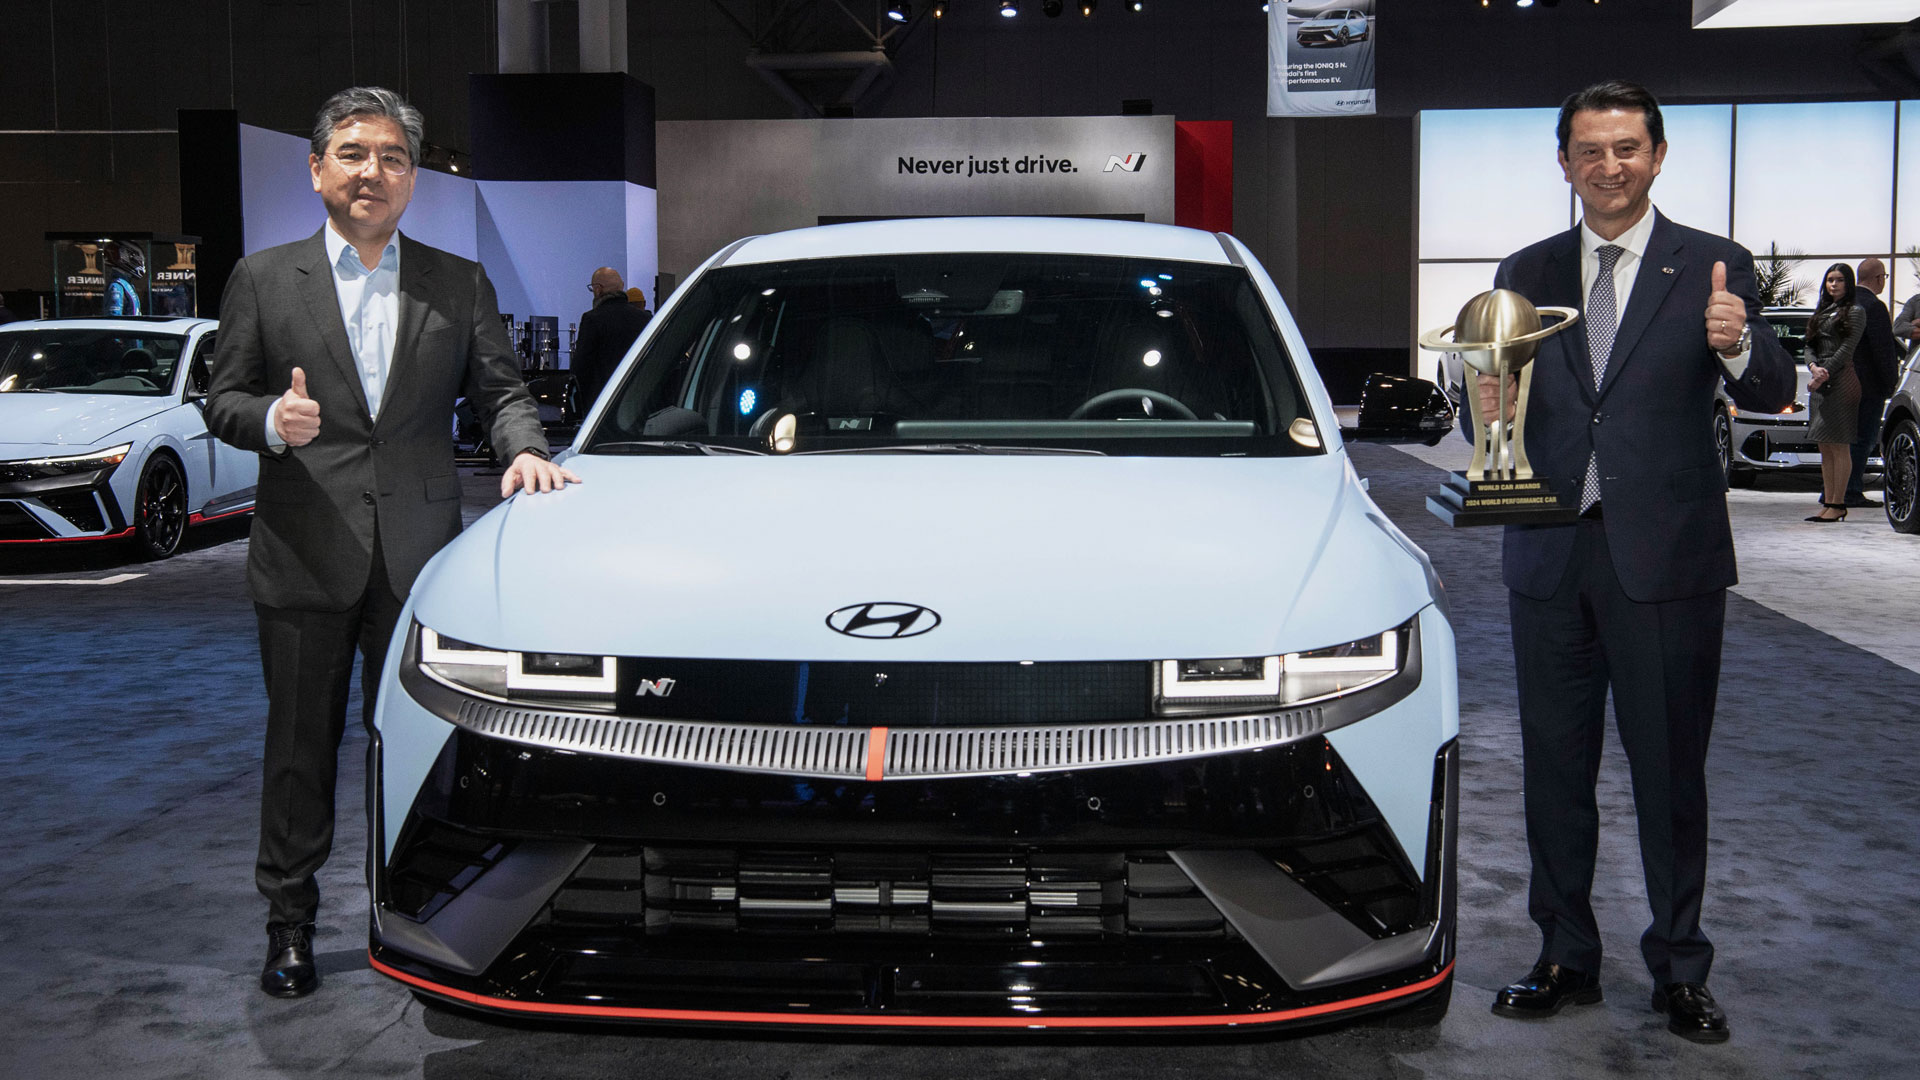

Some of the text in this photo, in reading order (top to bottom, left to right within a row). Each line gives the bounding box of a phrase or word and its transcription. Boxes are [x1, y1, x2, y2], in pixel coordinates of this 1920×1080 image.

[1273, 70, 1304, 78] ndai's
[1273, 77, 1330, 85] -performance
[898, 155, 1078, 178] Never just drive.
[1514, 482, 1541, 490] AWARDS
[1465, 499, 1480, 507] 2024
[1480, 498, 1501, 506] WORLD
[1501, 497, 1544, 505] PERFORMANCE
